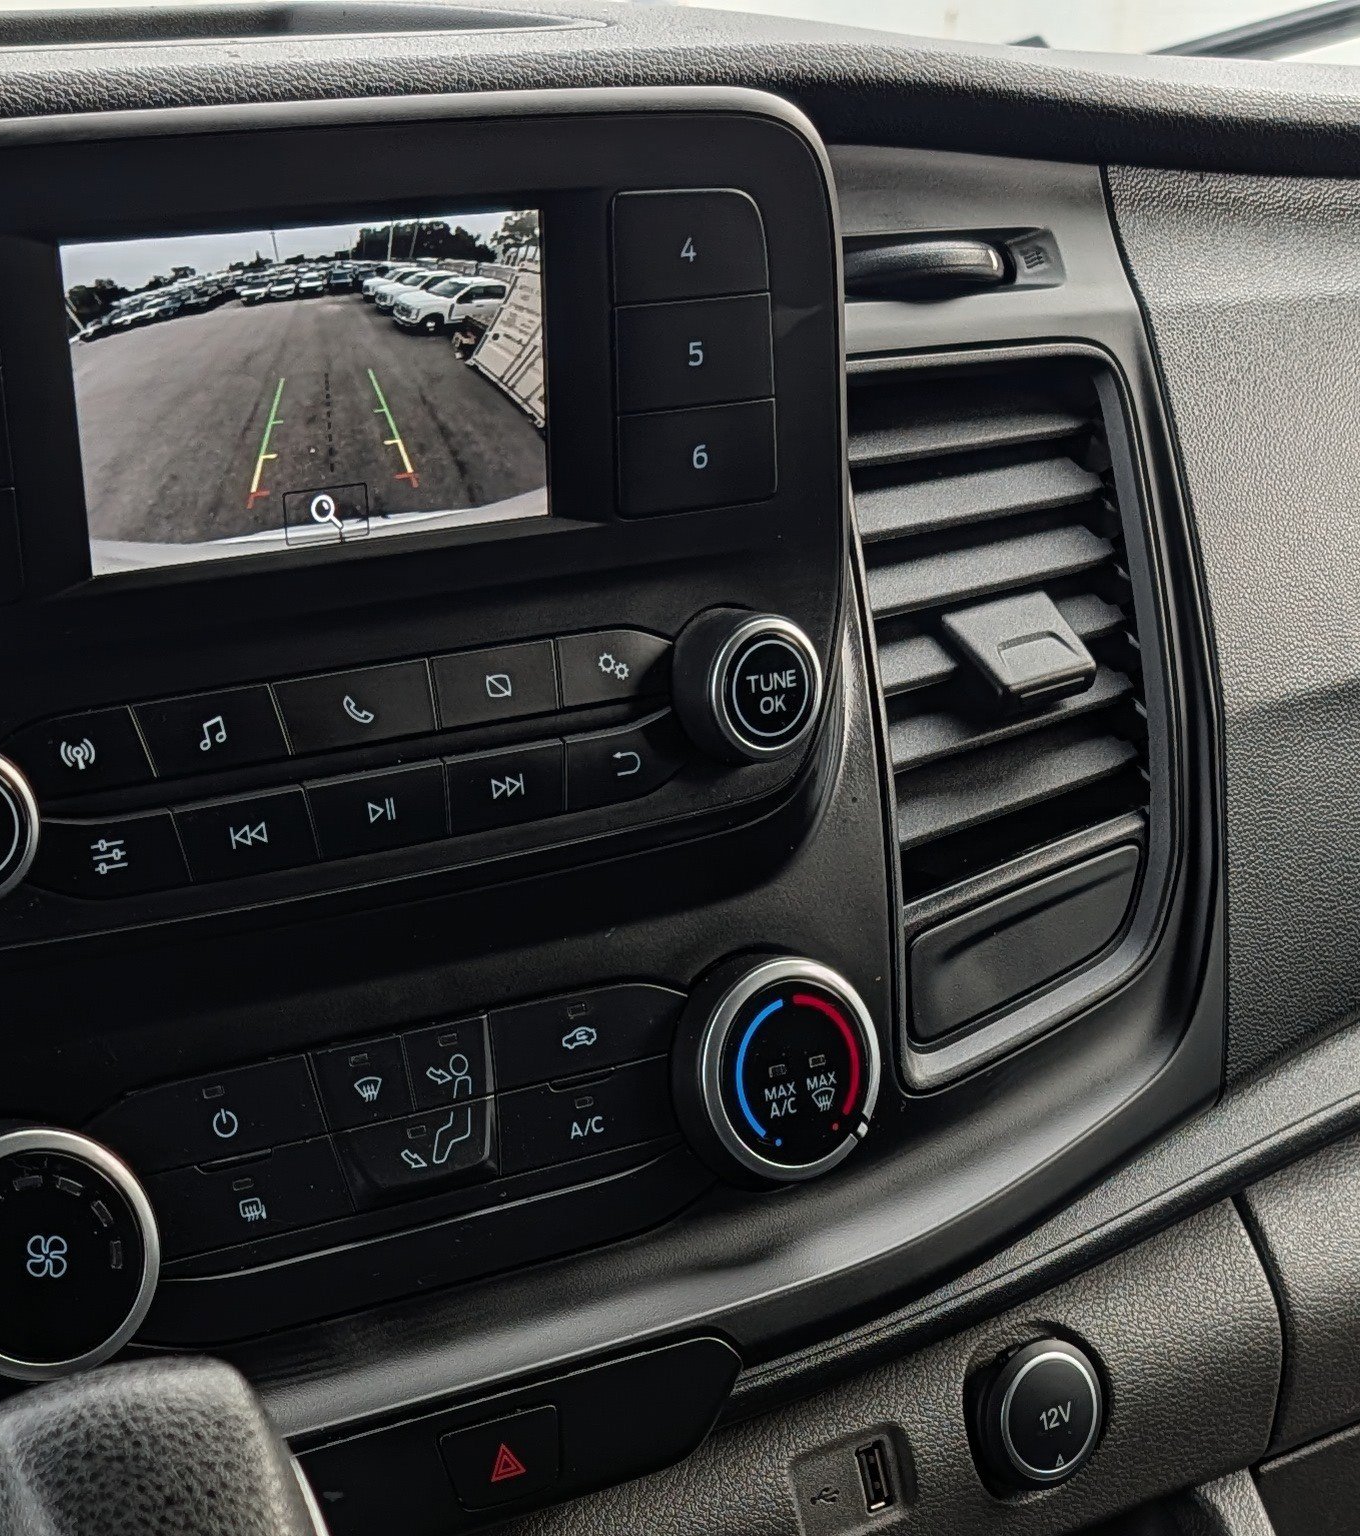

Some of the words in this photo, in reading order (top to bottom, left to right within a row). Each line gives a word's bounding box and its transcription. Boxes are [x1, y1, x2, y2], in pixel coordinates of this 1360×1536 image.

[680, 237, 697, 262] 4
[687, 341, 705, 367] 5
[692, 444, 708, 470] 6
[745, 669, 797, 693] TUNE
[759, 693, 787, 715] OK
[764, 1081, 797, 1102] MAX
[806, 1071, 837, 1091] MAX
[770, 1097, 797, 1119] A/C
[570, 1115, 604, 1140] A/C
[1039, 1400, 1072, 1431] 12V
